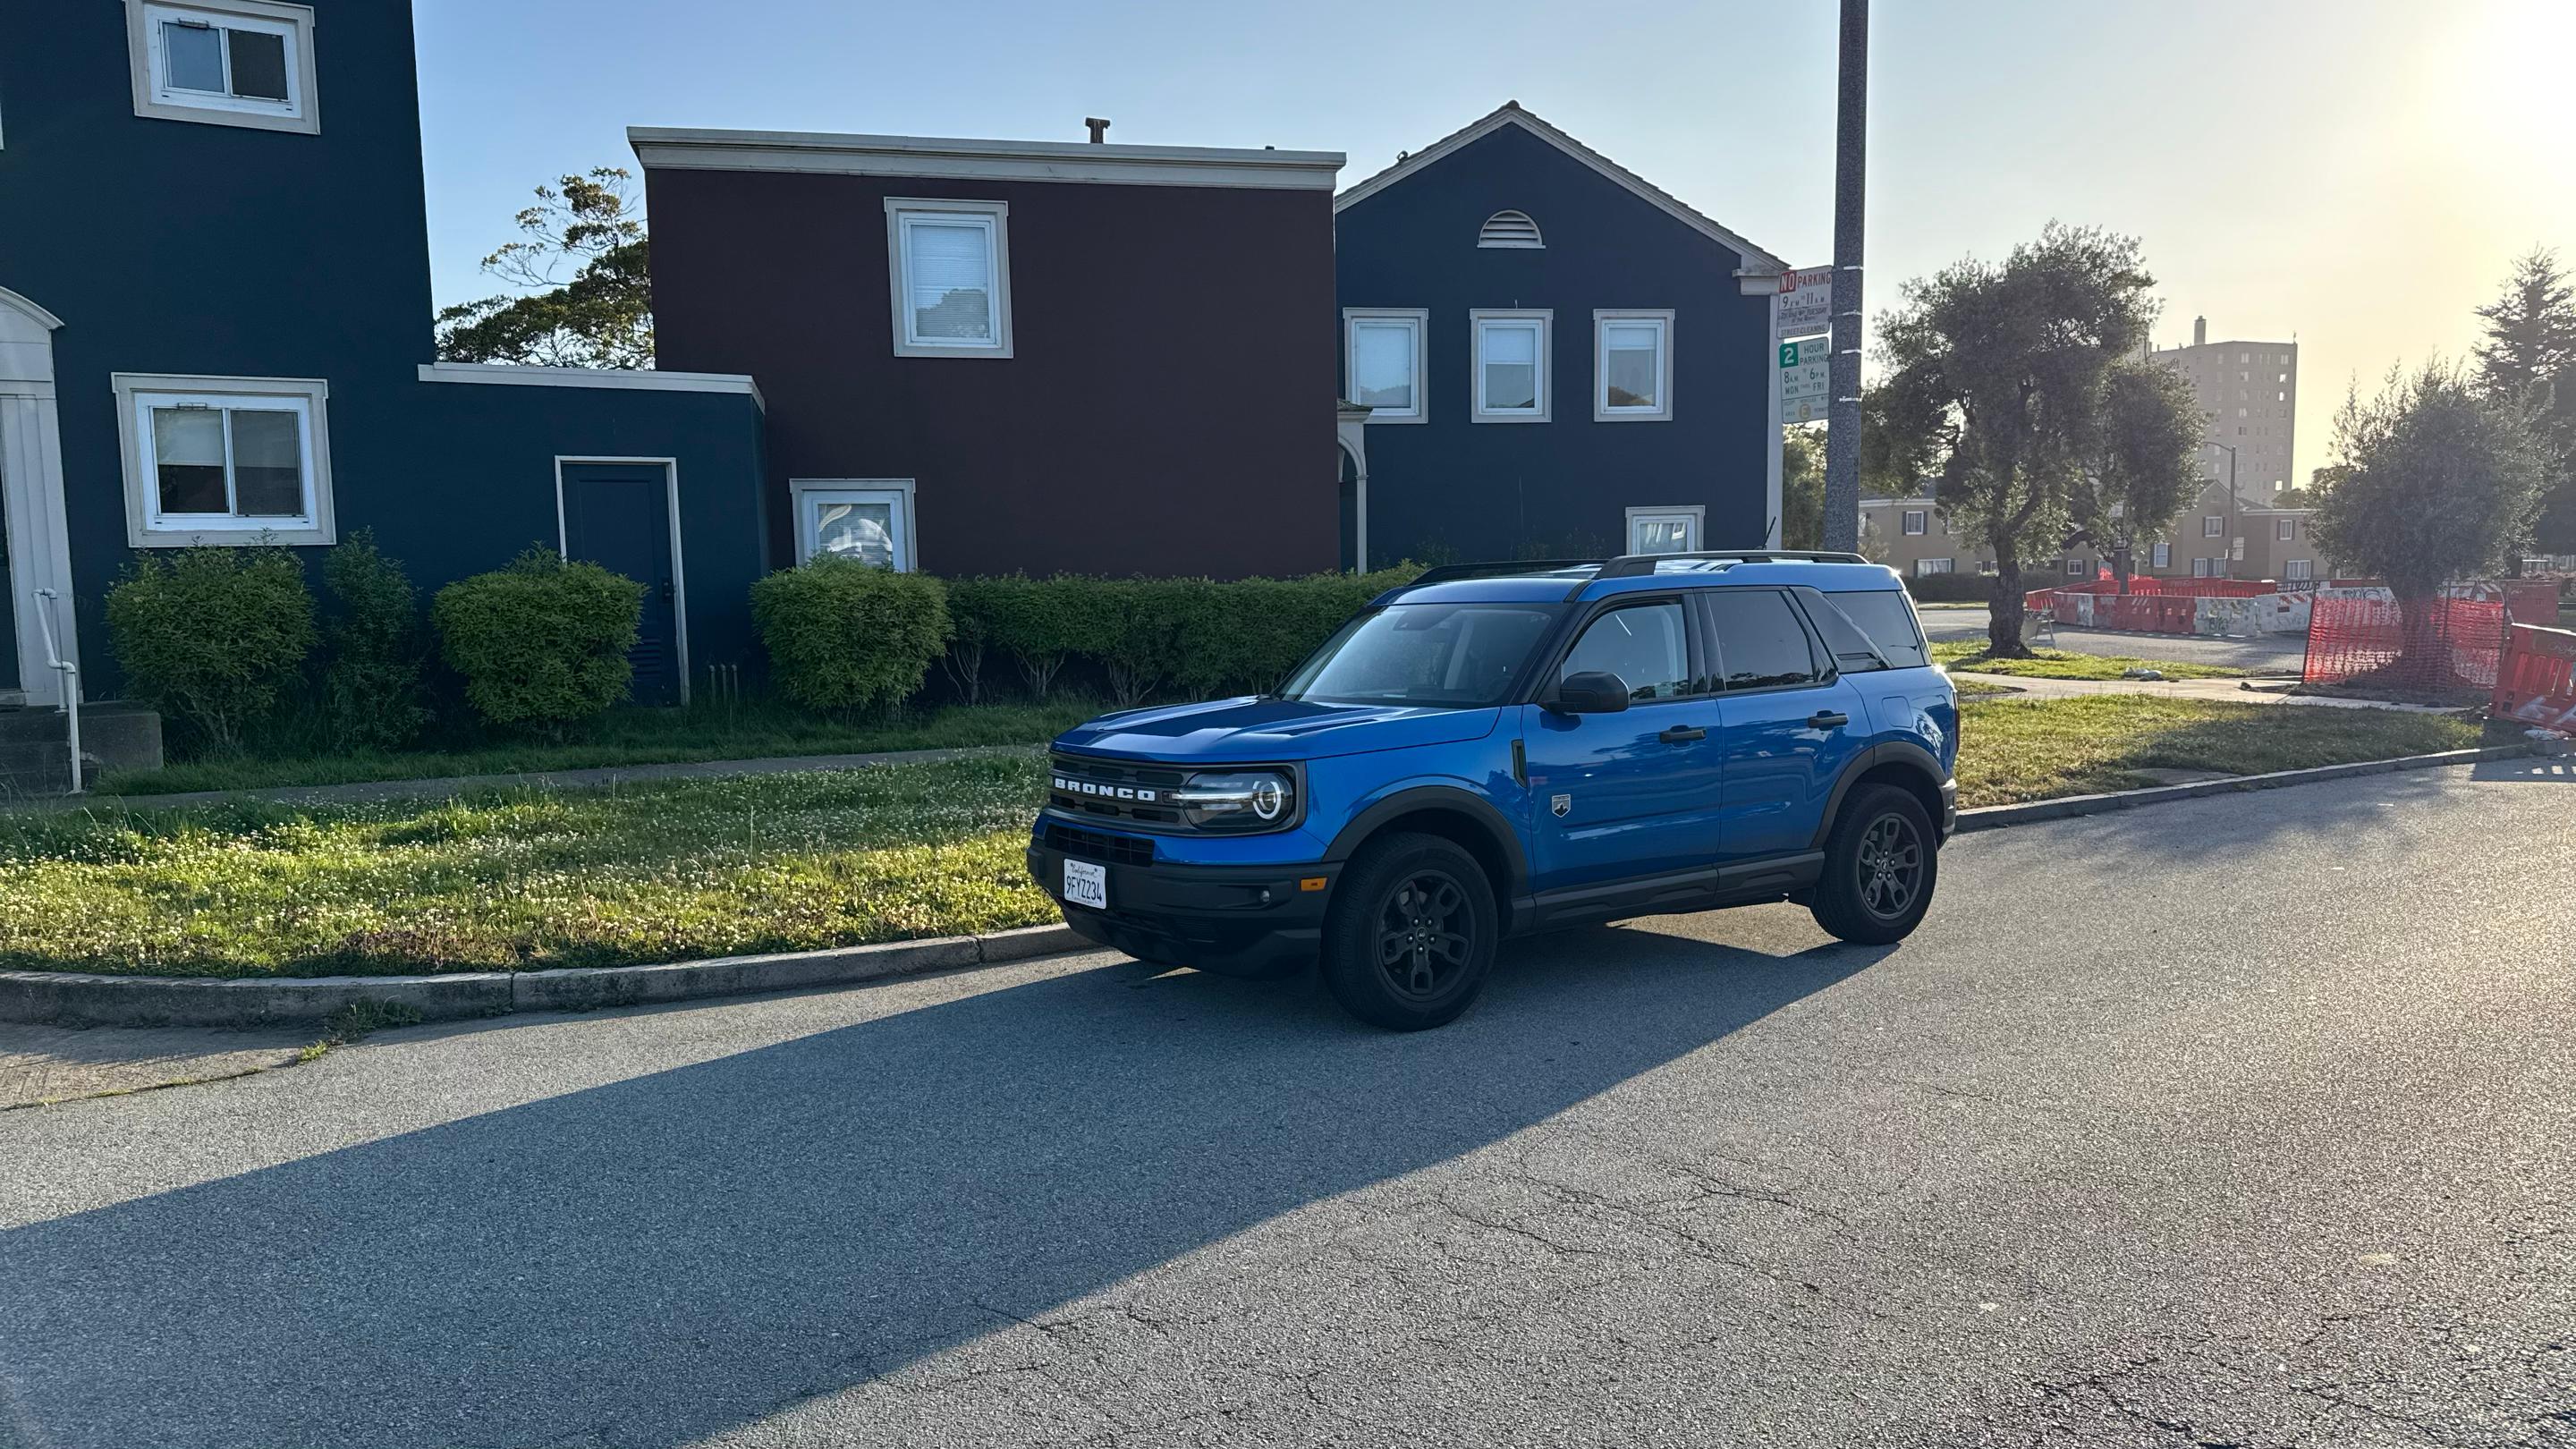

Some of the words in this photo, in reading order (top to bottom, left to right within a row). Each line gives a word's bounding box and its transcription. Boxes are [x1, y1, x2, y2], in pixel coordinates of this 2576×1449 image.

[1781, 273, 1795, 292] NO
[1798, 271, 1831, 288] PARKING
[1783, 296, 1789, 308] 9
[1807, 292, 1814, 305] 11
[1800, 324, 1826, 335] CLEANING
[1784, 347, 1794, 364] 2
[1803, 343, 1824, 353] HOUR
[1784, 371, 1790, 384] 8
[1809, 368, 1816, 380] 6
[1784, 386, 1799, 394] MON
[1813, 382, 1825, 391] FRI
[1055, 777, 1156, 801] BRONCO
[1066, 875, 1102, 902] 9FYZ234
